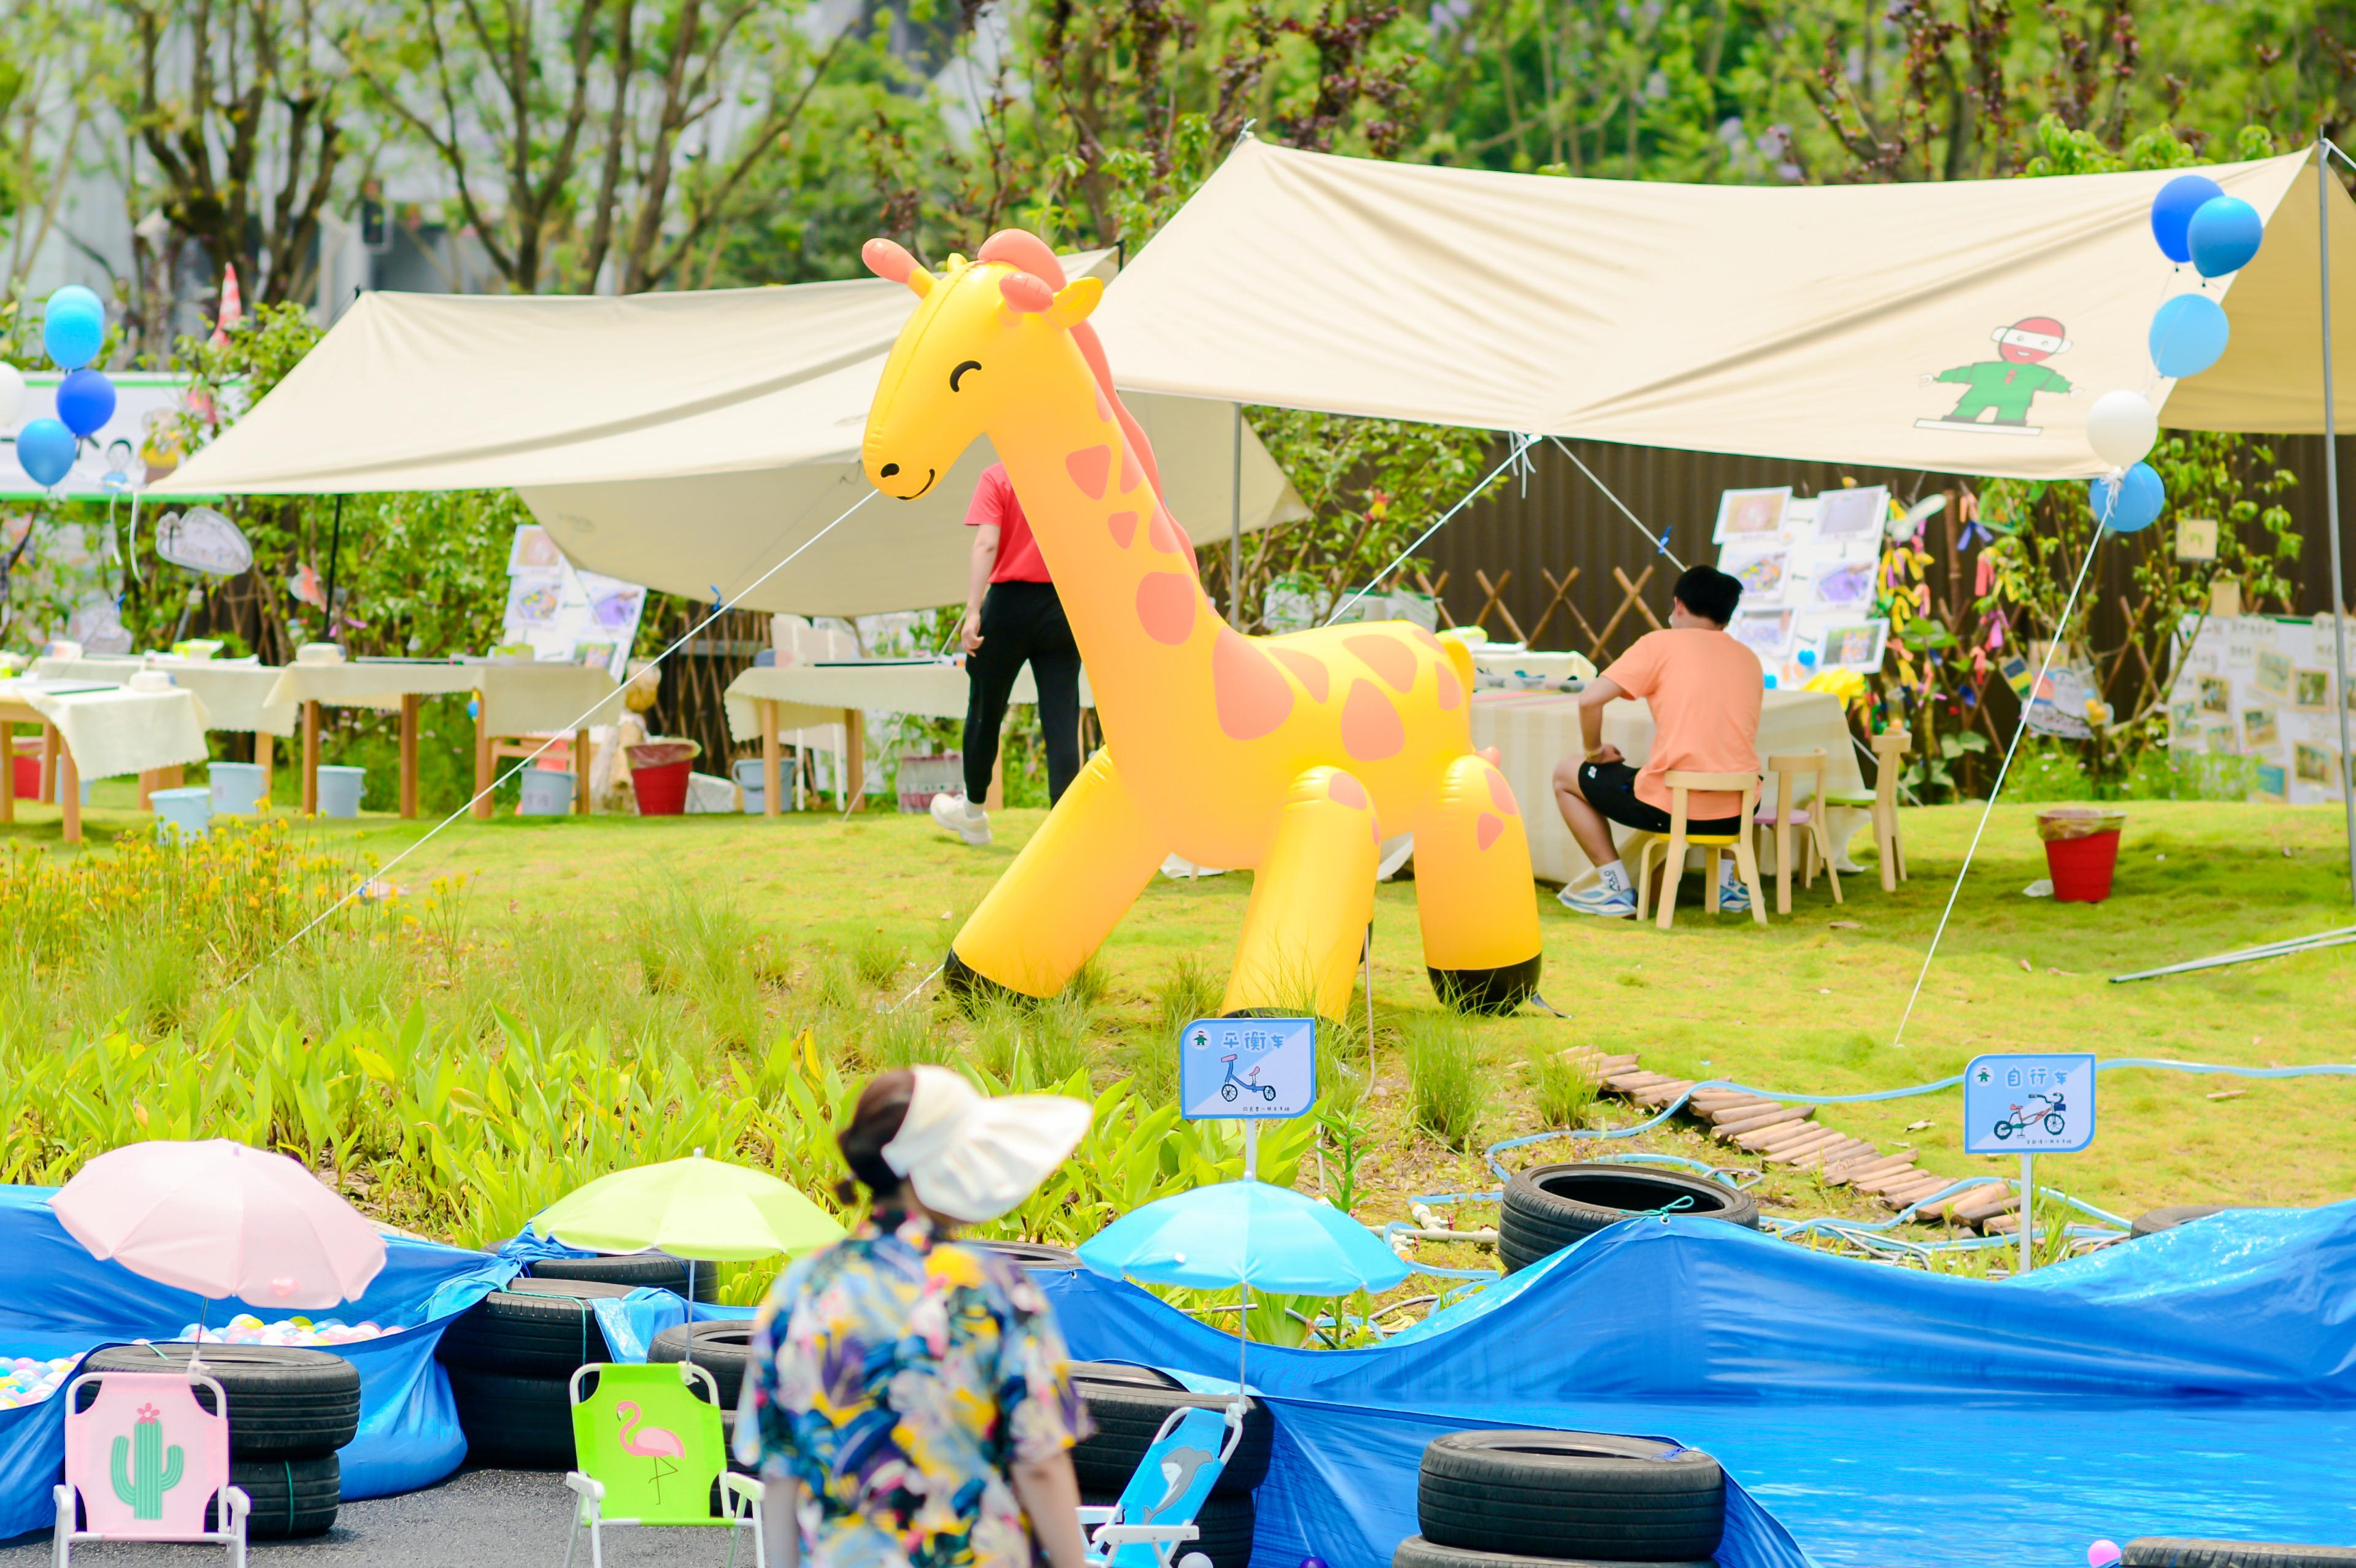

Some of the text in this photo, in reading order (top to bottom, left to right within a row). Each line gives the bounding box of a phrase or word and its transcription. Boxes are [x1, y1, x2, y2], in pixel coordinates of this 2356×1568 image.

[1223, 1031, 1284, 1051] 平衡车
[2007, 1067, 2068, 1086] 自行车
